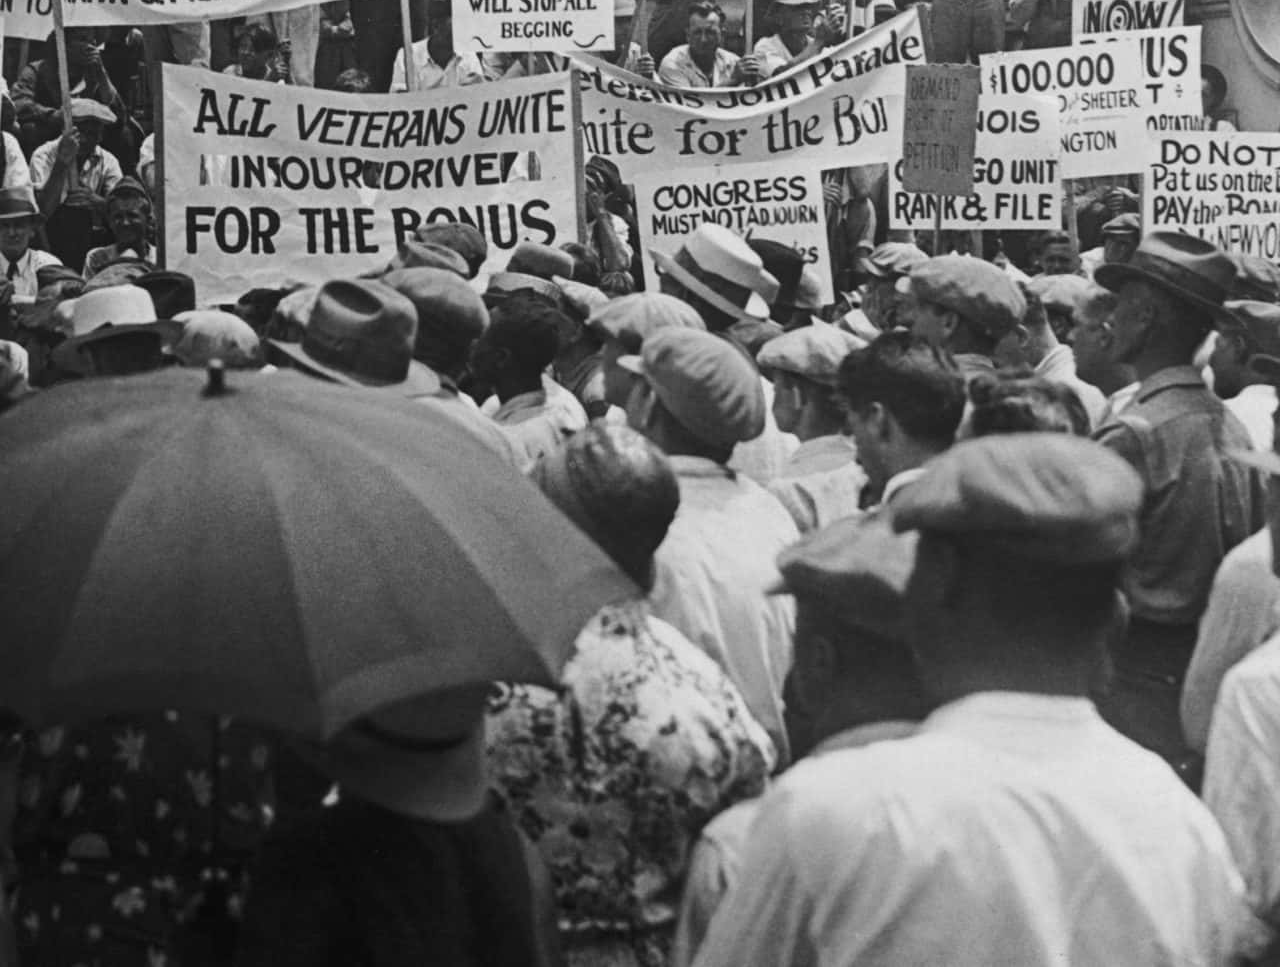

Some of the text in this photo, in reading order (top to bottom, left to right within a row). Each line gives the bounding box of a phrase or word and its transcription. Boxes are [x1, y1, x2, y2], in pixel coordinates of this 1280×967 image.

[501, 20, 574, 39] BEGGING
[808, 29, 922, 88] Parade
[1080, 89, 1140, 111] SHELTER
[193, 88, 566, 148] ALL VETERANS UNITE
[674, 118, 748, 157] for
[761, 107, 824, 153] the
[384, 153, 501, 191] DRIVE
[1010, 159, 1058, 184] UNIT
[1150, 164, 1244, 192] Pat us on
[653, 175, 808, 212] CONGRESS
[895, 192, 1053, 225] RANK FILE
[1153, 195, 1192, 225] PAY
[186, 206, 379, 254] FOR THE
[652, 204, 818, 235] MUST ADJOURN
